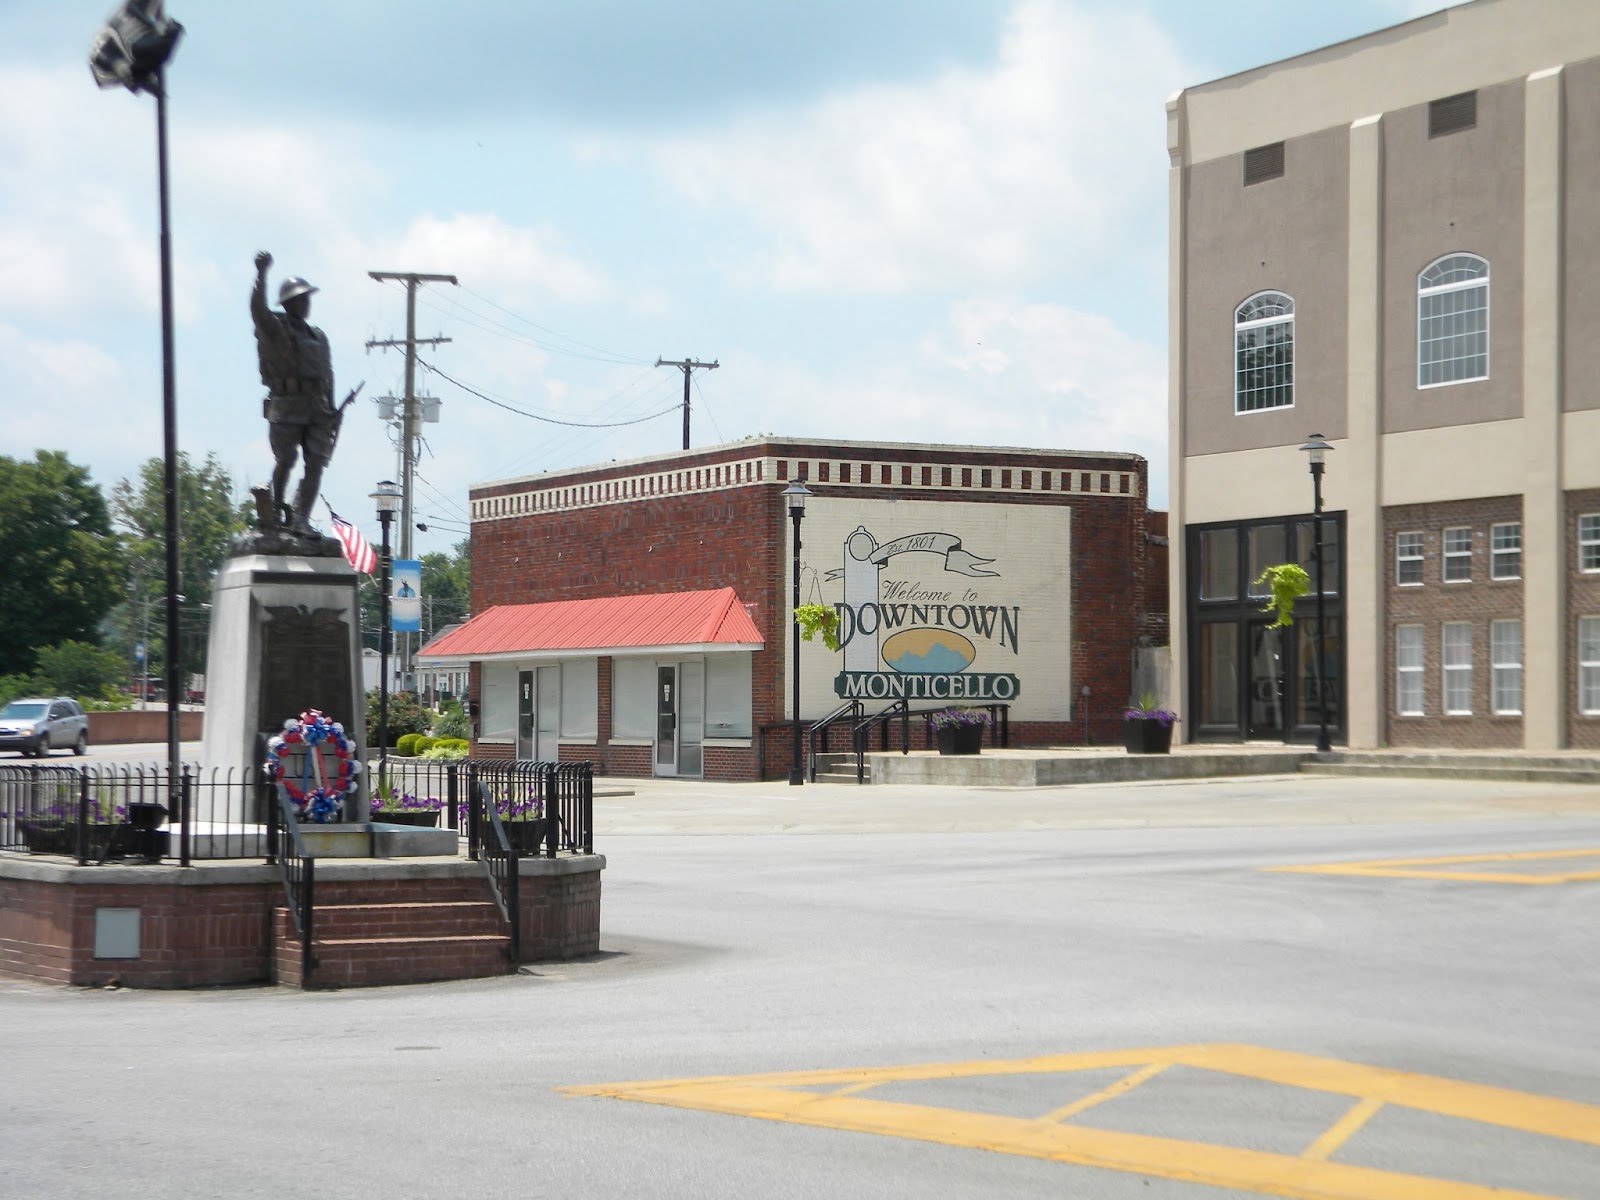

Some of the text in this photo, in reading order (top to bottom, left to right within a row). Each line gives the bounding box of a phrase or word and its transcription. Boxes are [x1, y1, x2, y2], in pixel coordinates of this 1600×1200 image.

[907, 536, 936, 550] 1801
[882, 580, 978, 601] Welcome to
[834, 602, 1020, 655] DOWNTOWN
[844, 674, 1014, 698] MONTICELLO
